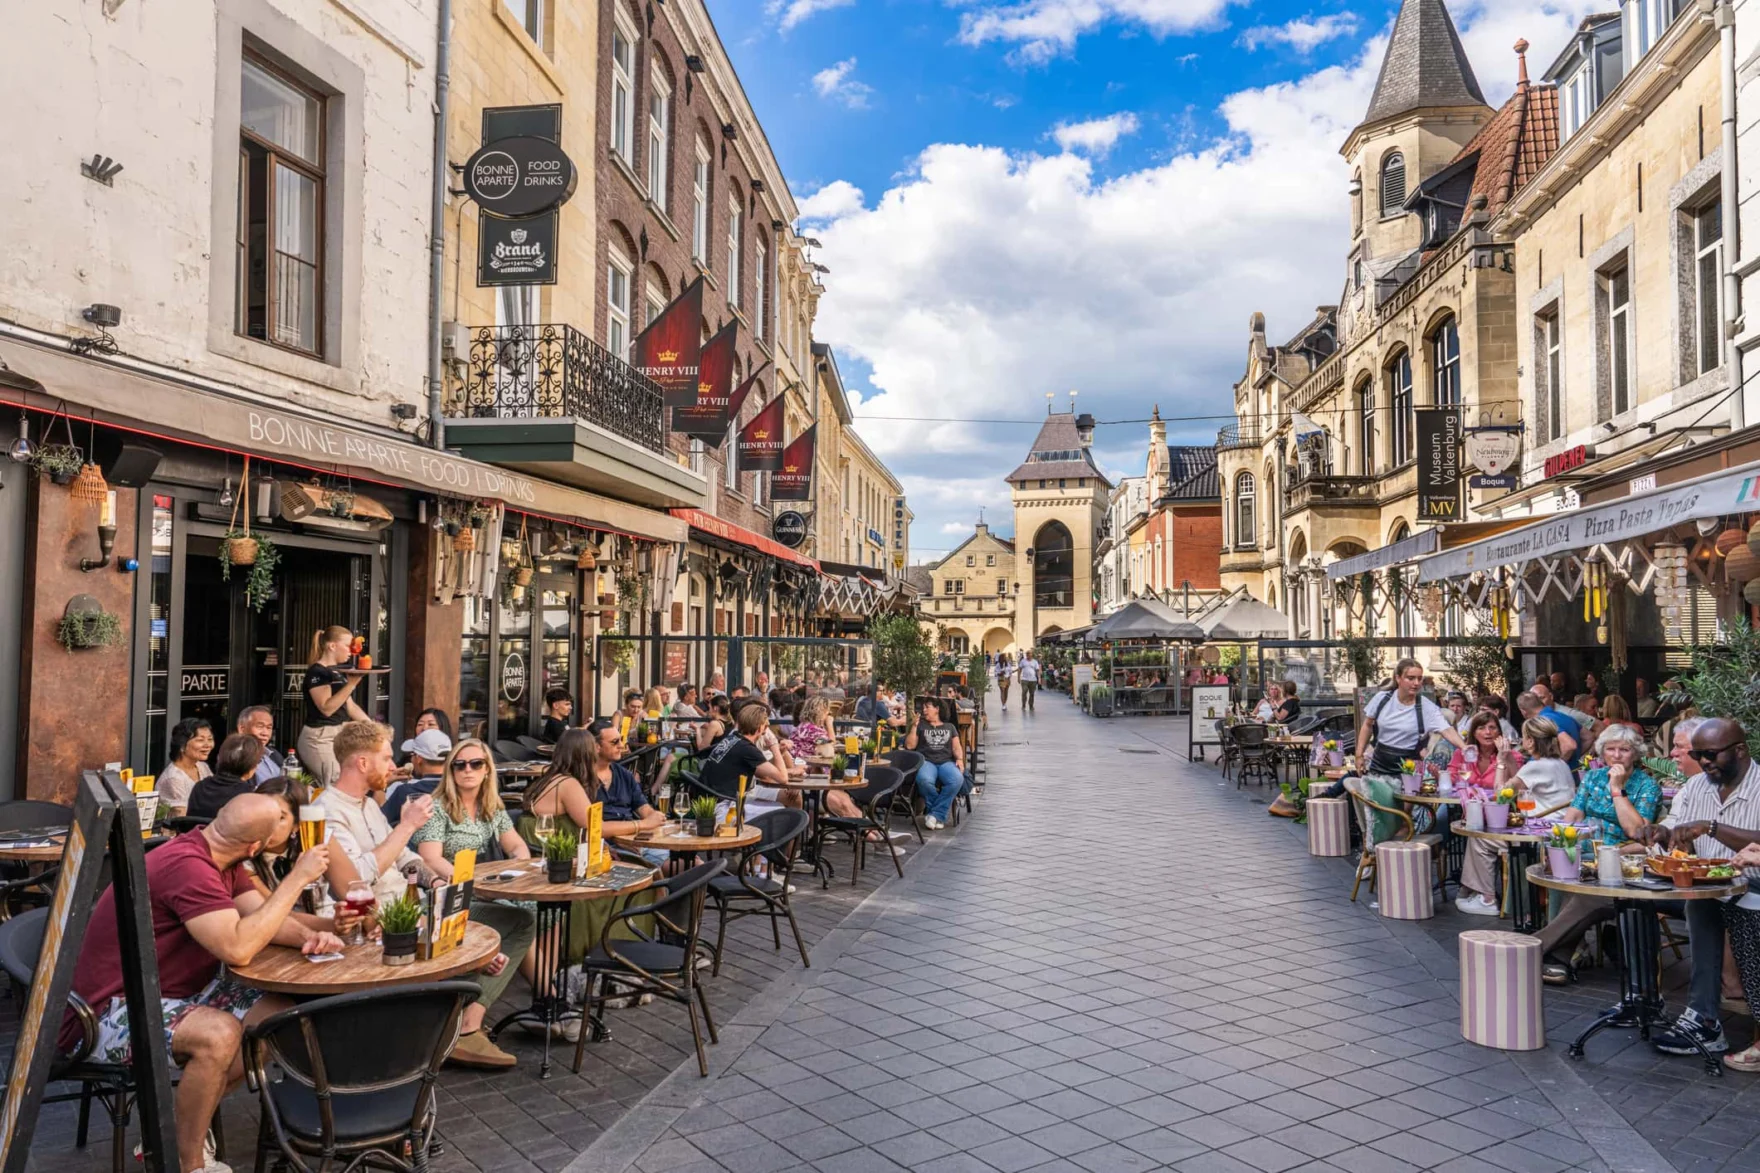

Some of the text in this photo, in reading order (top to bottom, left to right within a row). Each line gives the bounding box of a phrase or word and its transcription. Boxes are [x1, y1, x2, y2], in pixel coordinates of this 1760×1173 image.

[476, 165, 515, 175] BONNE
[528, 160, 560, 171] FOOD
[476, 175, 514, 186] APARTE
[524, 175, 563, 186] DRINKS
[495, 241, 541, 258] Brand
[637, 365, 699, 376] HENRY VIII
[710, 397, 729, 406] VIII
[739, 441, 783, 449] HENRY VIII
[1442, 415, 1457, 485] Valkenburg
[249, 412, 341, 455] BONNE
[345, 437, 412, 473] APARTE
[420, 456, 470, 487] FOOD
[485, 471, 535, 502] DRINKS
[1429, 432, 1442, 485] Museum
[1544, 444, 1586, 479] GULPENER
[1480, 477, 1506, 486] Boque
[1633, 476, 1654, 492] PIZZA
[1429, 501, 1456, 515] MV
[1584, 494, 1700, 538] Pizza Pasta Tapas
[895, 500, 903, 550] HOTEL
[1532, 532, 1545, 550] LA
[1546, 523, 1571, 546] CASA
[505, 666, 523, 677] BONNE
[180, 674, 226, 691] PARTE
[505, 677, 523, 688] APARTE
[1199, 694, 1223, 702] BOQUE
